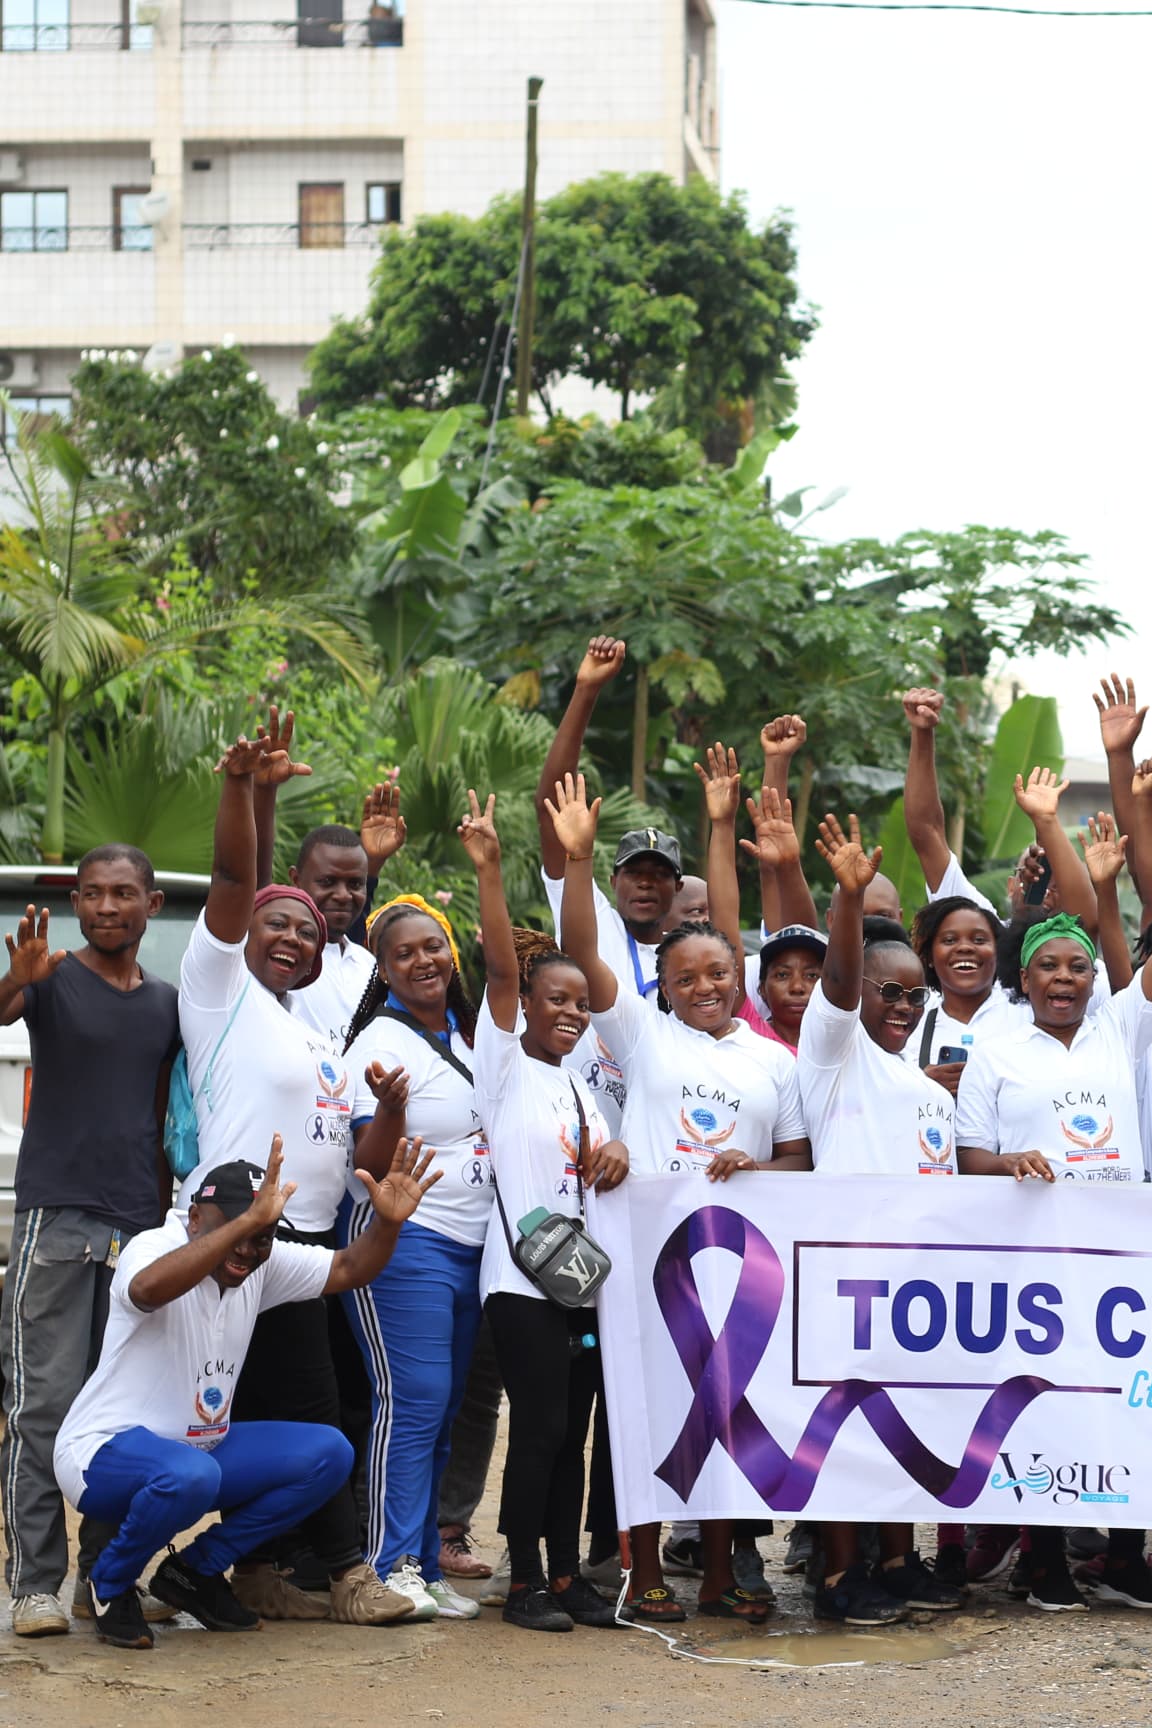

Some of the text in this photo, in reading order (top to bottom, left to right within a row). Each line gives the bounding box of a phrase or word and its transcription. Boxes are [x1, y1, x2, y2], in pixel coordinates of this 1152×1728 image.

[682, 1084, 741, 1112] ACMA
[1053, 1091, 1106, 1112] ACMA
[918, 1103, 952, 1125] ACMA
[530, 1223, 565, 1261] LOUIS VUITTON
[837, 1279, 1064, 1355] TOUS
